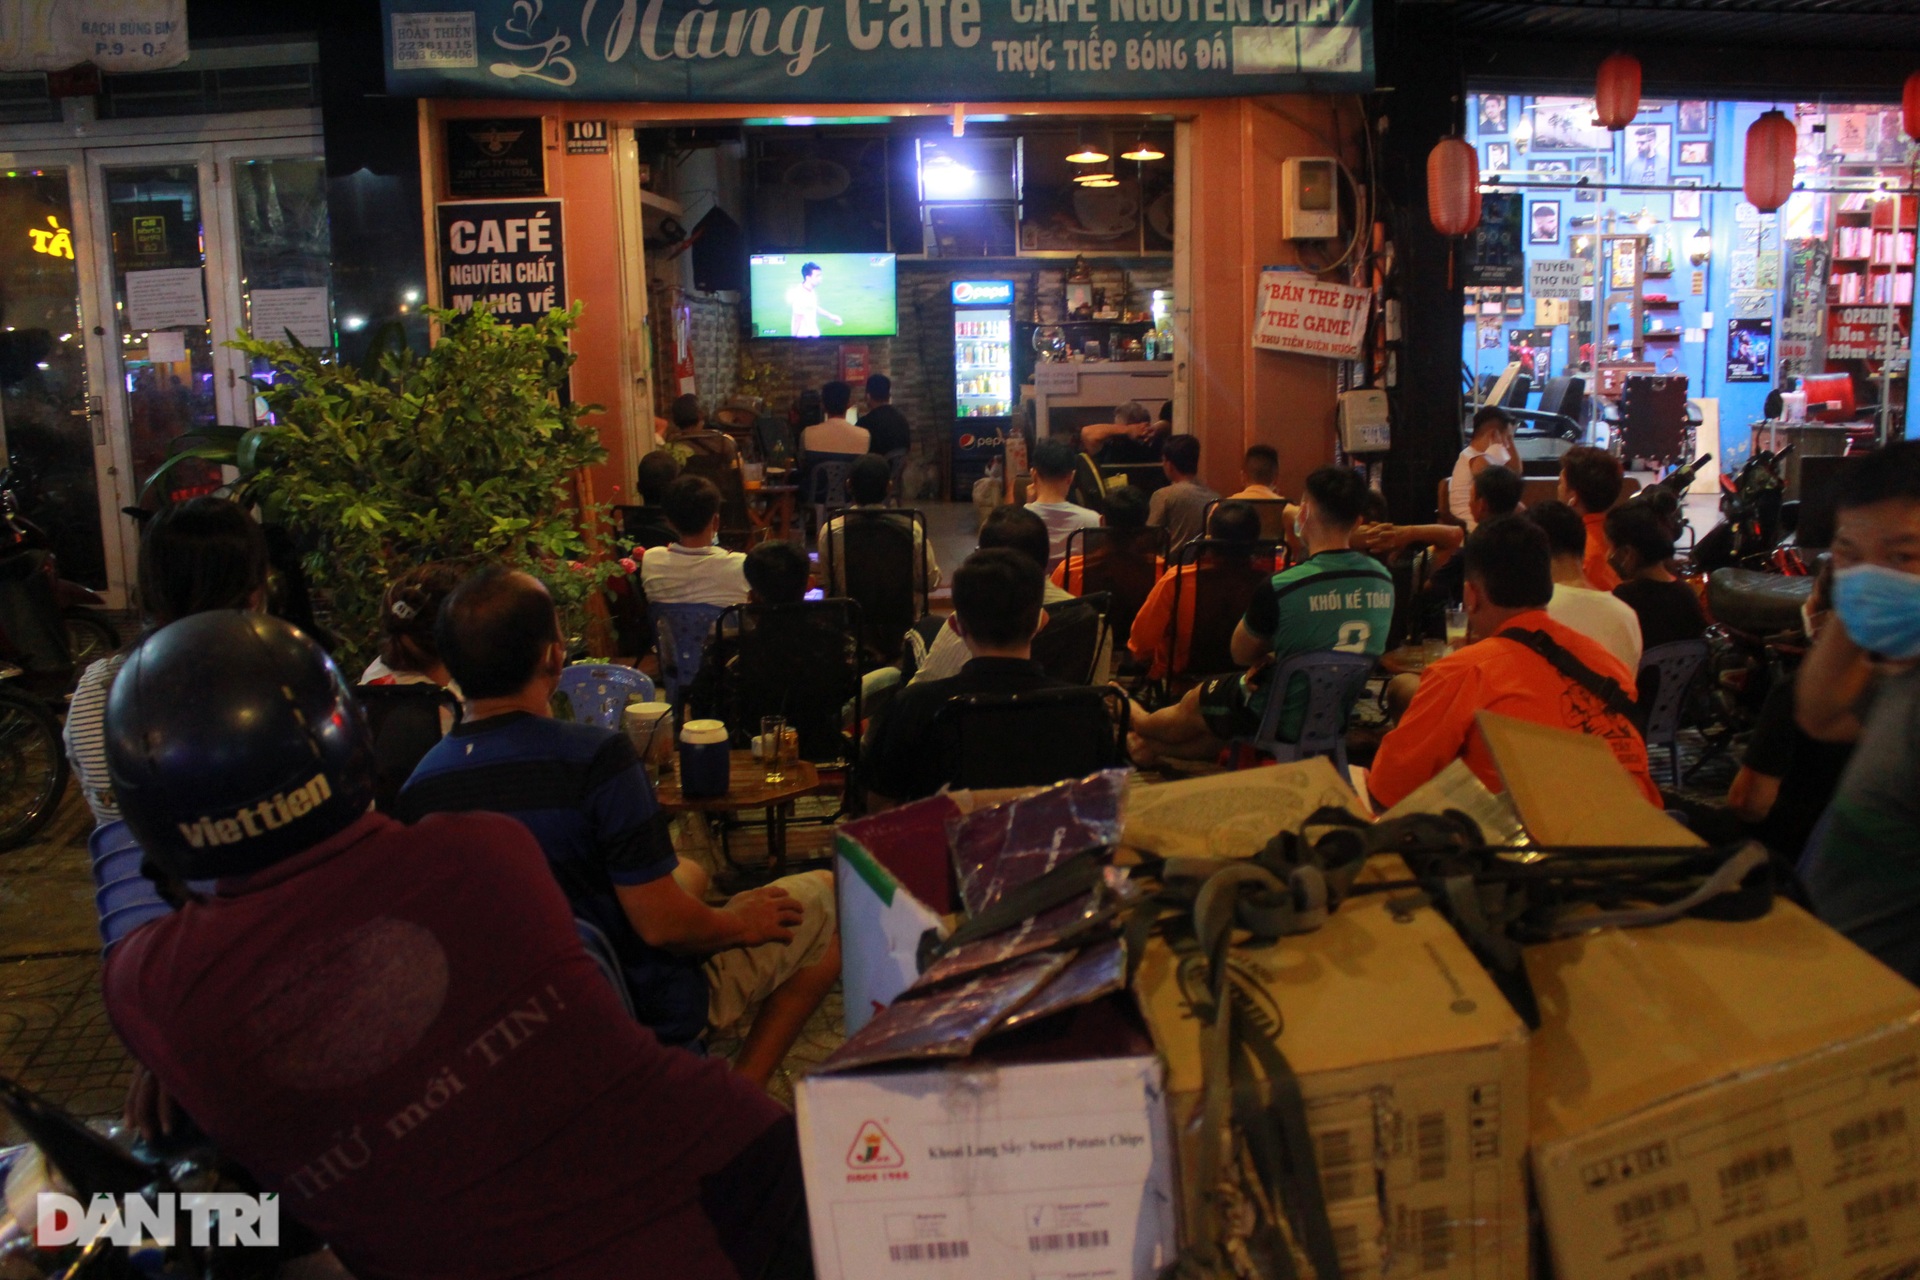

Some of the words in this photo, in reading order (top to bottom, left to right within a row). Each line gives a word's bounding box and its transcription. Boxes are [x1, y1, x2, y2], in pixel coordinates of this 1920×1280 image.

[95, 42, 124, 56] P.9
[993, 33, 1056, 77] TRỰC
[1063, 28, 1117, 72] TIẾP
[1126, 32, 1188, 71] BÓNG
[1196, 31, 1227, 70] ĐÁ
[573, 122, 603, 139] 101
[479, 167, 537, 178] CONTROL
[450, 211, 553, 255] CAFÉ
[450, 259, 512, 286] NGUYÊN
[515, 255, 556, 283] CHẤT
[452, 291, 522, 315] MNG
[971, 284, 1011, 301] pepsi
[1270, 280, 1304, 302] BÁN
[1308, 286, 1340, 307] THẺ
[1342, 293, 1366, 311] ĐT
[1268, 308, 1300, 329] THẺ
[1303, 315, 1351, 336] GAME
[1261, 334, 1280, 345] THU
[1308, 588, 1342, 612] KHỐI
[1345, 587, 1363, 609] KẾ
[178, 772, 333, 848] viettien
[385, 1066, 466, 1140] mới
